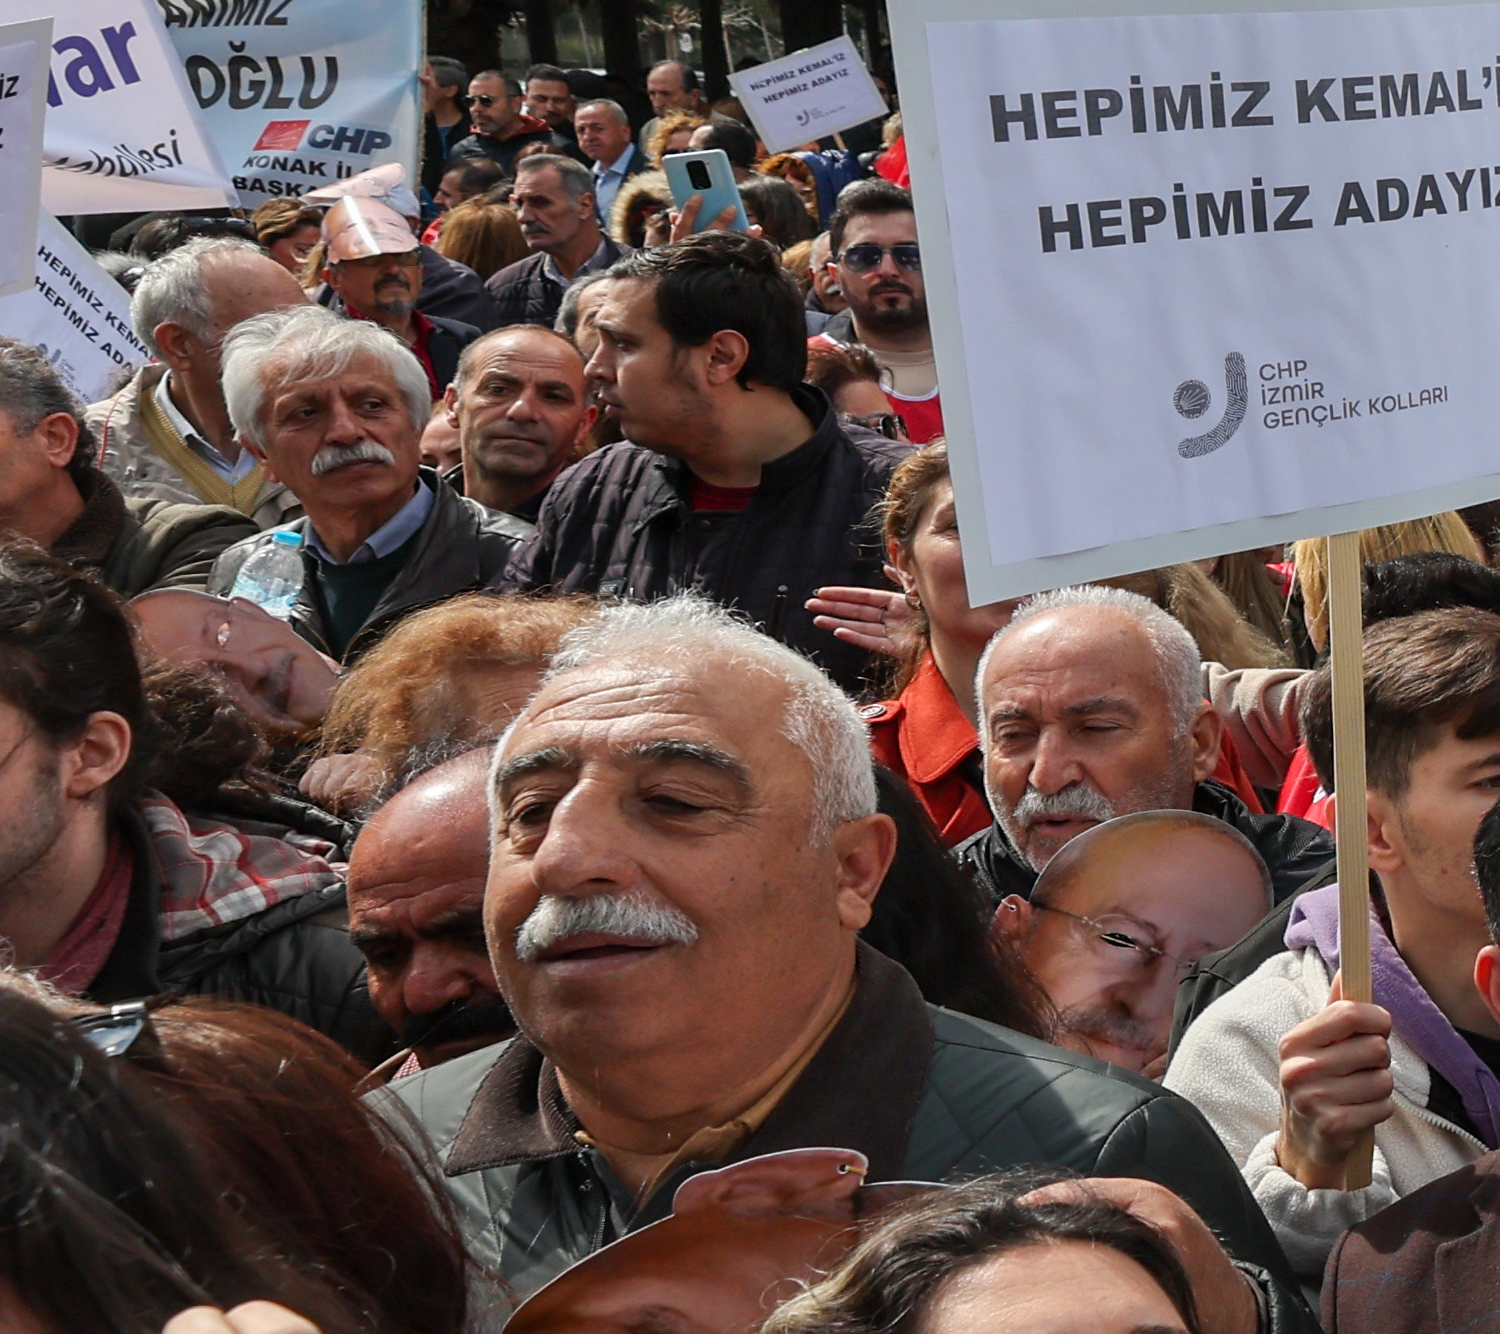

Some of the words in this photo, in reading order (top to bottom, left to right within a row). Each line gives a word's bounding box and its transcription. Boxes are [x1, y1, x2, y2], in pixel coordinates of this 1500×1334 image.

[750, 70, 795, 91] HEPİMİZ
[764, 83, 809, 103] HEPİMİZ
[812, 69, 849, 88] ADAYIZ
[988, 71, 1275, 143] HEPİMİZ
[307, 124, 392, 155] CHP
[242, 156, 326, 177] KONAK
[336, 160, 371, 179] İL
[1038, 176, 1312, 254] HEPİMİZ
[35, 276, 100, 343] HEPİMİZ
[37, 246, 104, 313] HEPİMİZ
[105, 311, 153, 360] KEMA
[1259, 360, 1307, 381] CHP
[1263, 398, 1362, 429] GENÇLİK
[1368, 386, 1448, 415] KOLLARI
